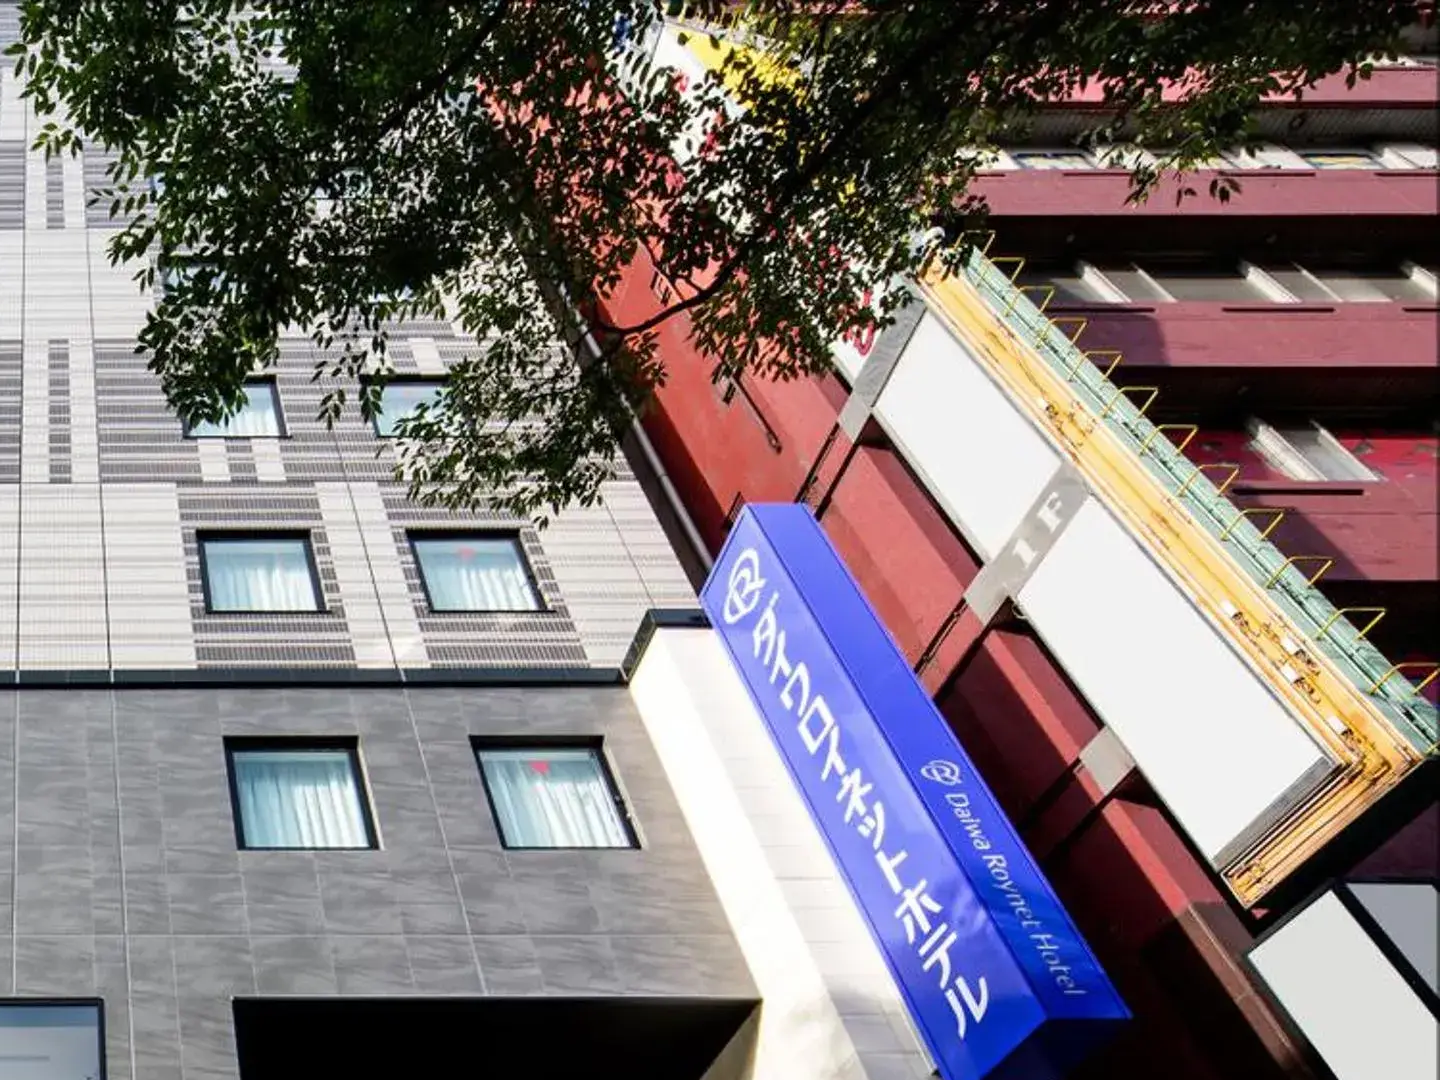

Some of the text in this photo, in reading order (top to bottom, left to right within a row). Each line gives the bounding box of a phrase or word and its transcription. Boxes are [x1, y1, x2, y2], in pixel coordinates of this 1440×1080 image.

[752, 592, 989, 1039] ダイワロイネットホテル
[944, 793, 1088, 994] Daiwa Roynet Hotel
